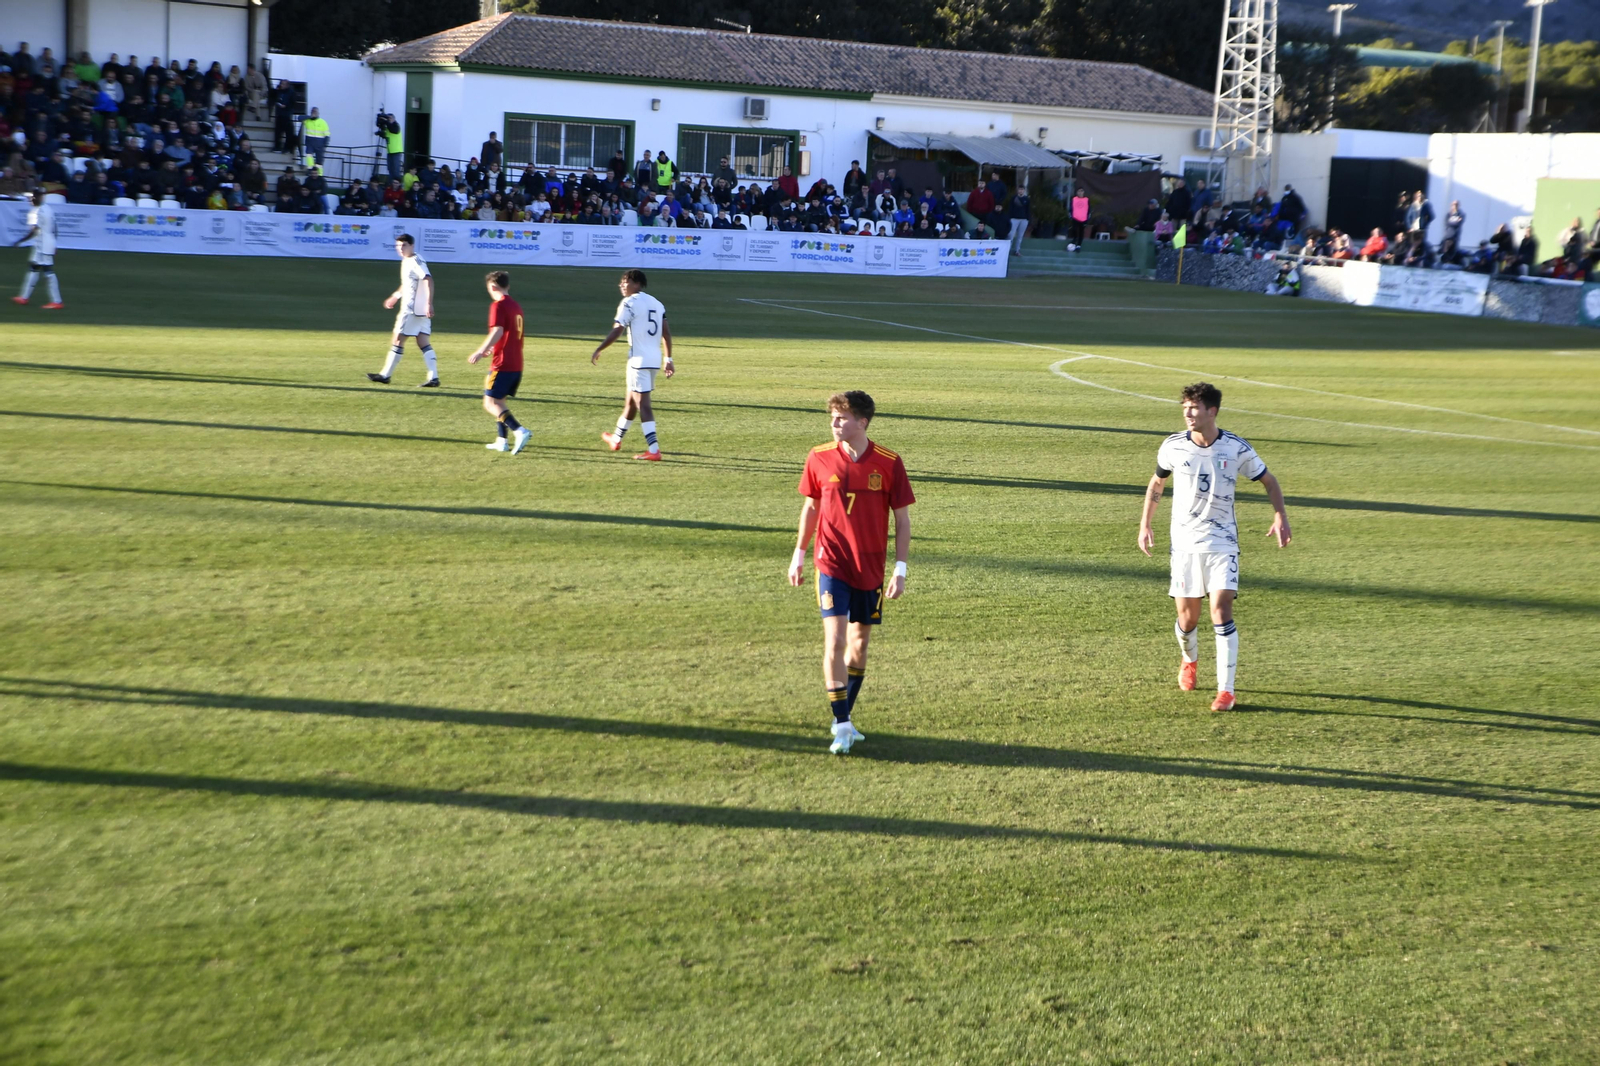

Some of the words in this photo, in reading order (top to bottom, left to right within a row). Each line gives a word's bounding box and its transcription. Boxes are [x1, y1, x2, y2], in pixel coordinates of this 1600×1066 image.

[106, 228, 186, 237] TORREMOLINOS
[294, 236, 370, 245] TORREMOLINOS
[470, 242, 540, 250] TORREMOLINOS
[790, 253, 854, 263] TORREMOLINOS
[516, 314, 524, 340] 9
[648, 310, 658, 336] 5
[1198, 474, 1210, 492] 3
[846, 492, 856, 515] 7
[1229, 555, 1238, 573] 3
[876, 588, 882, 610] 7
